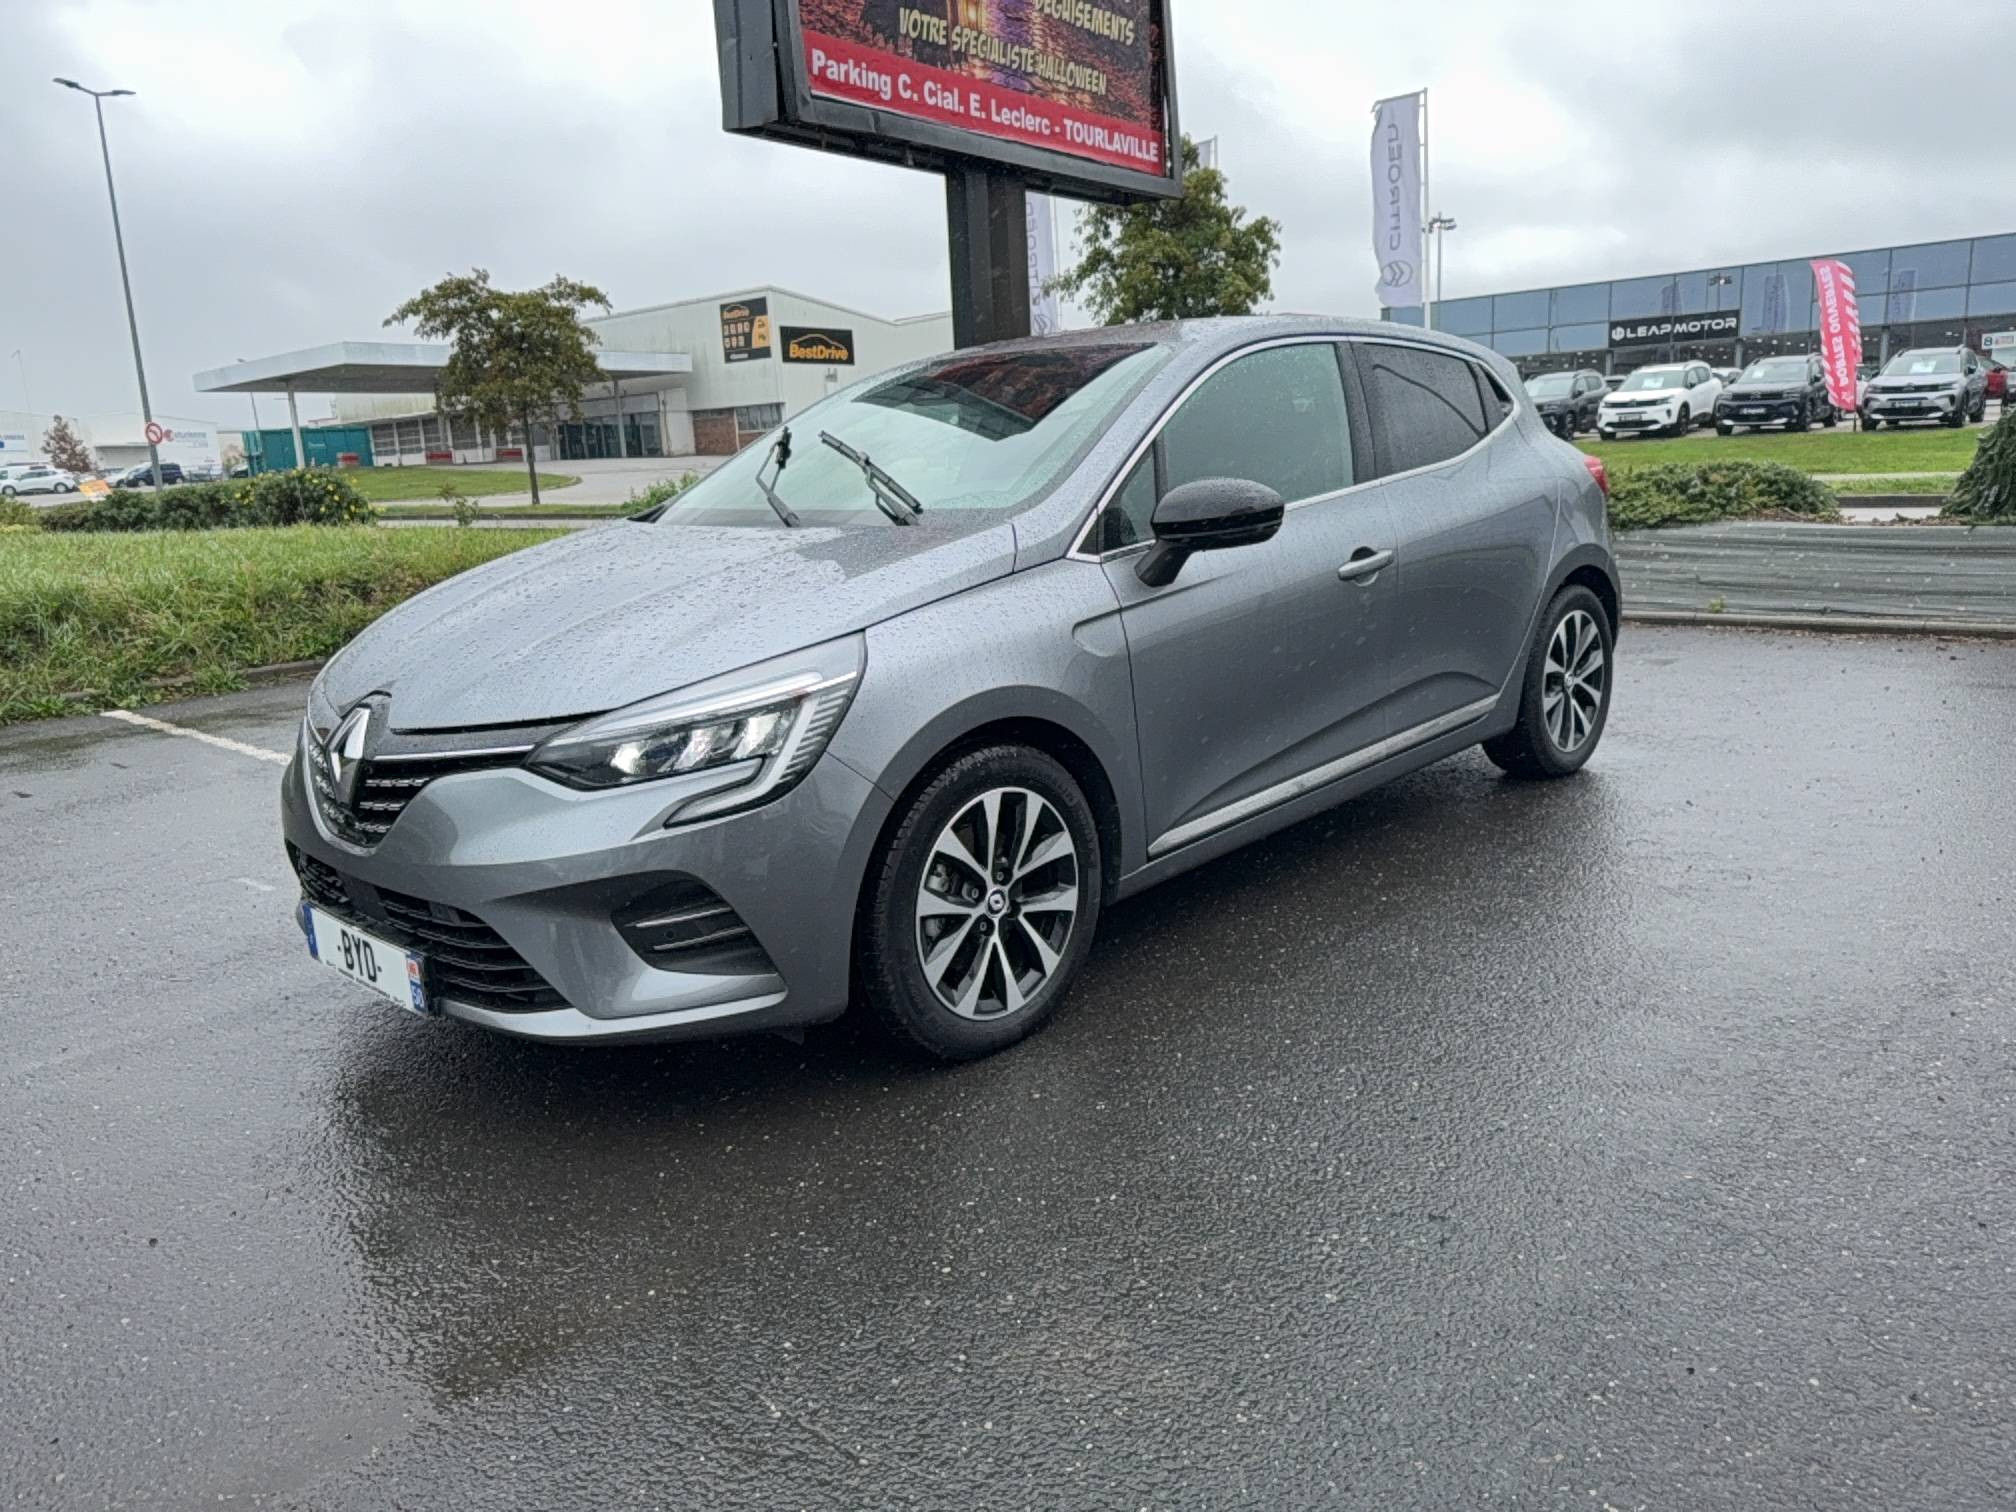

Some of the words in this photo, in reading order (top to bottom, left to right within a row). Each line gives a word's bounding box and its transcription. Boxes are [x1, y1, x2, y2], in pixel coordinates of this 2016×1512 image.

[900, 7, 948, 45] VOTRE
[951, 25, 1035, 73] SPECIALISTE
[811, 48, 892, 100] Parking
[898, 73, 919, 101] C.
[923, 80, 964, 115] Cial.
[969, 92, 986, 119] E.
[991, 98, 1051, 136] Leclerc
[1063, 118, 1160, 163] TOURLAVILLE
[789, 343, 849, 361] BestDrive
